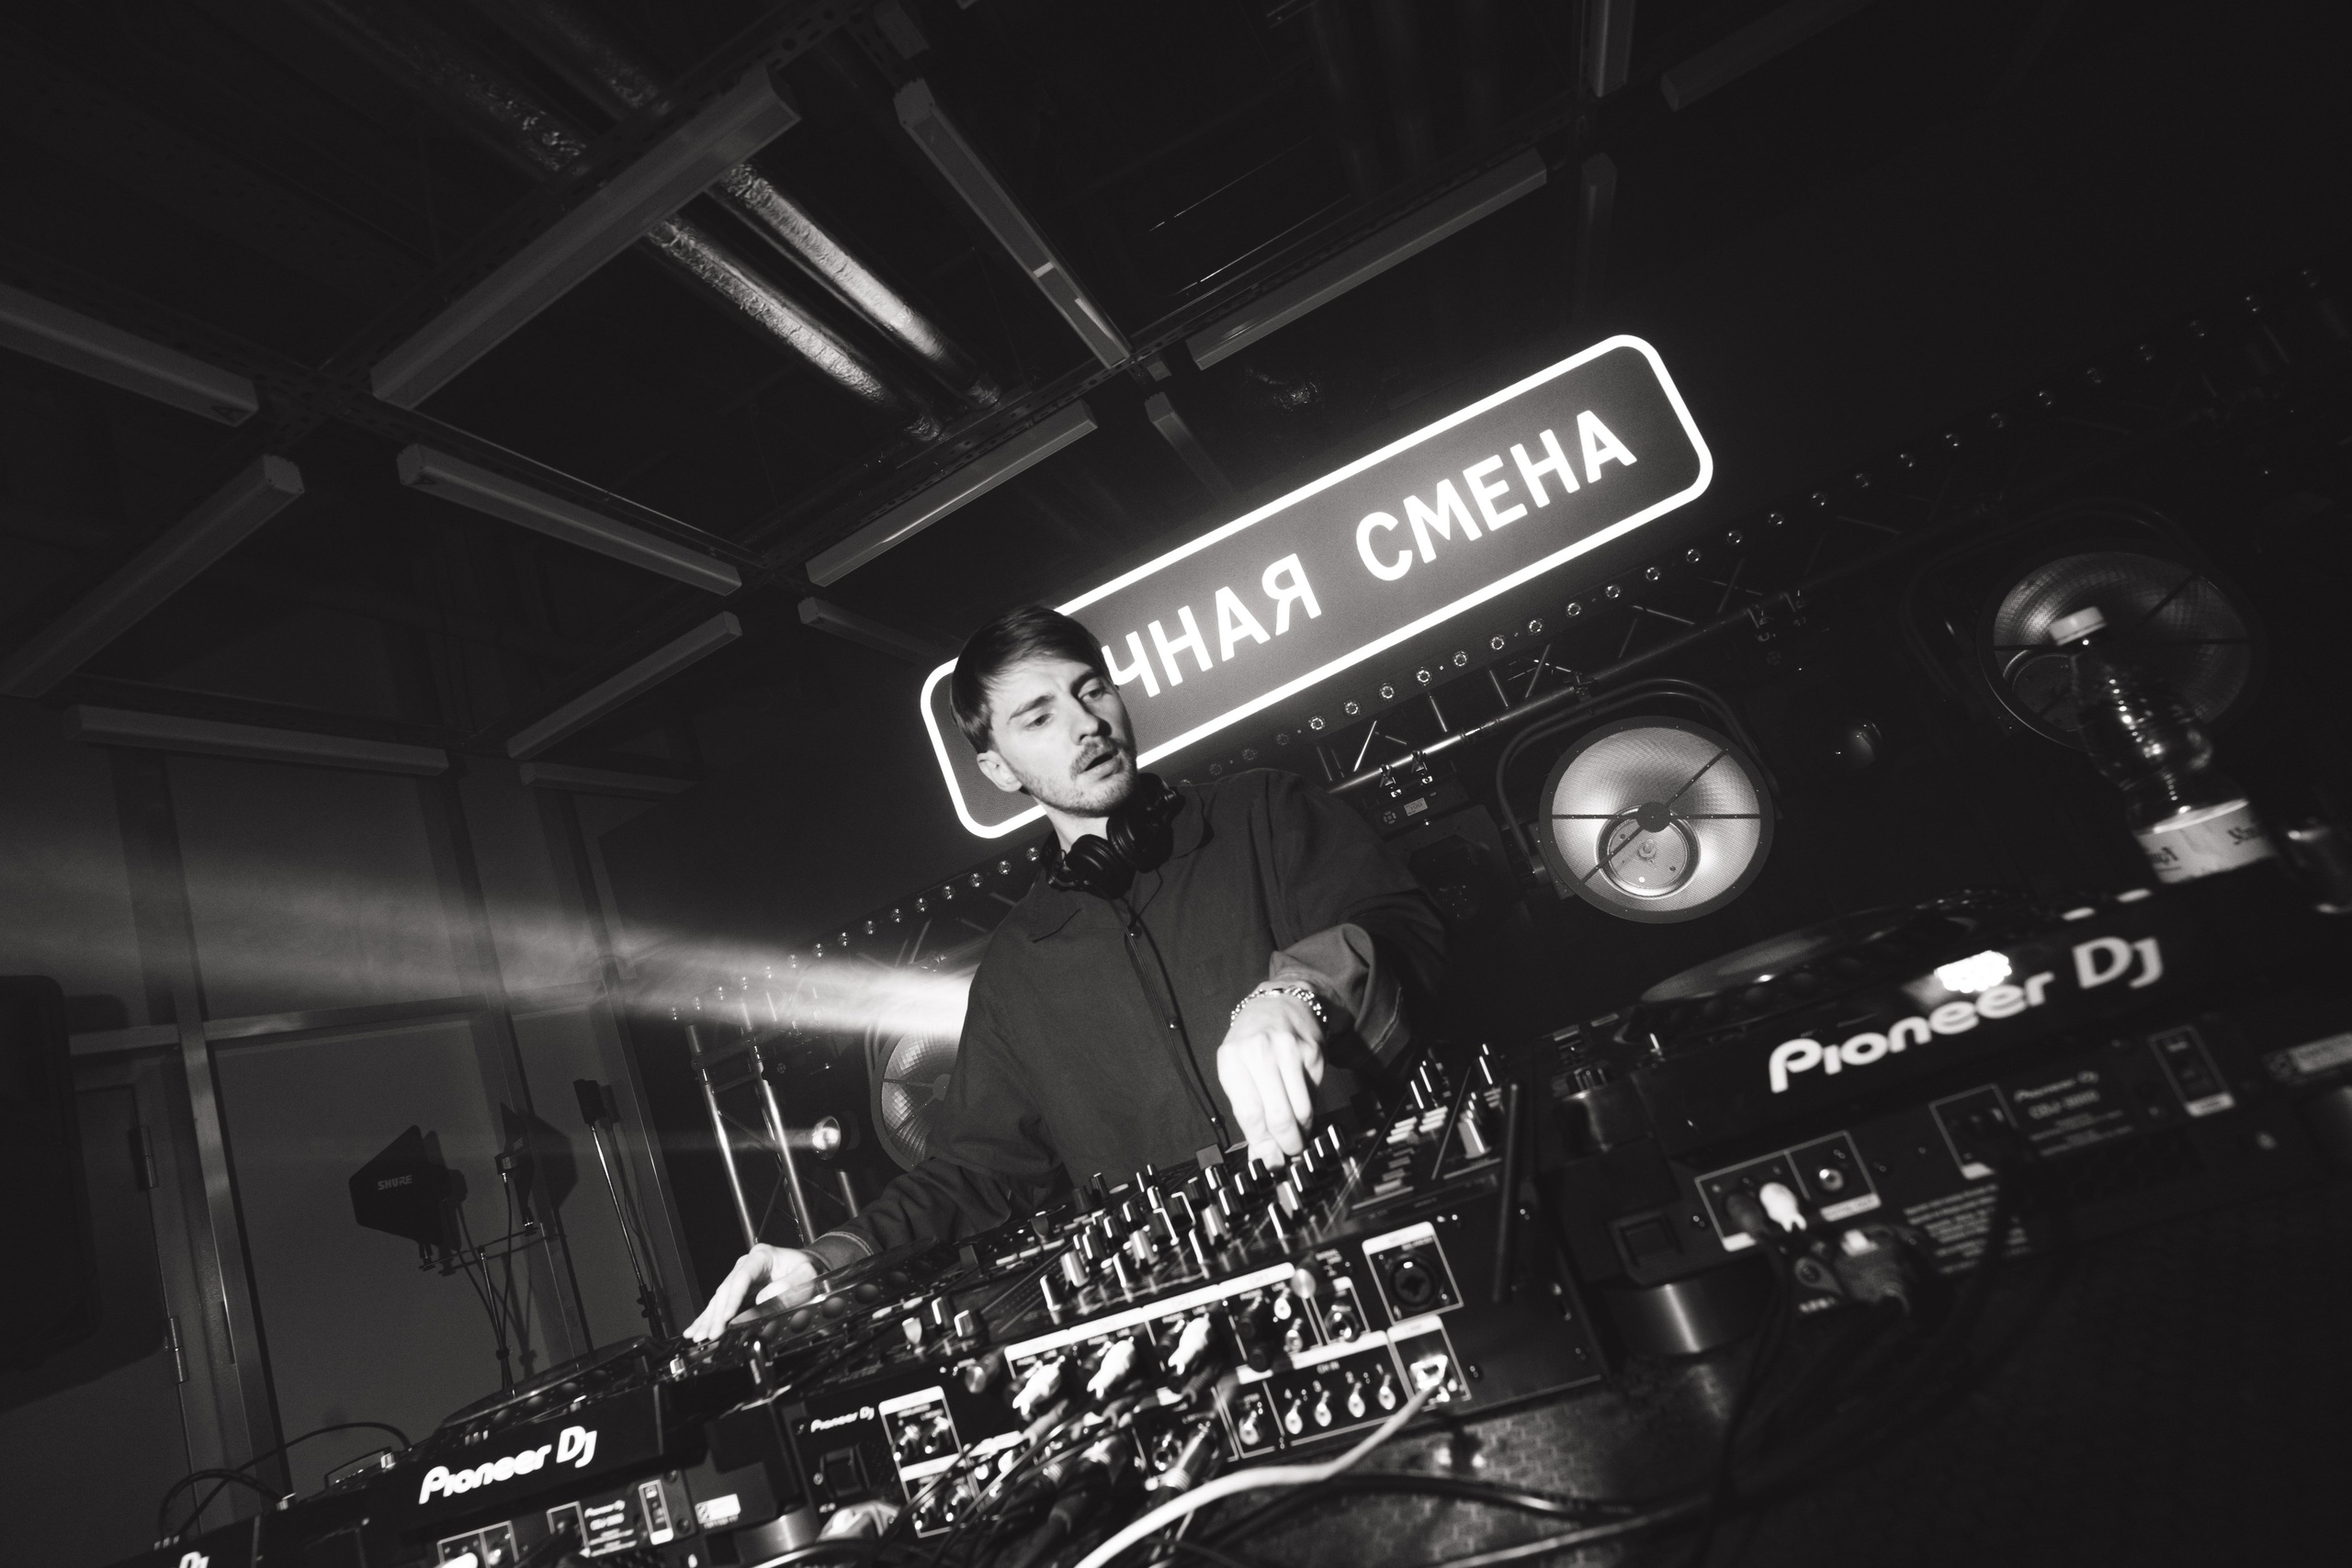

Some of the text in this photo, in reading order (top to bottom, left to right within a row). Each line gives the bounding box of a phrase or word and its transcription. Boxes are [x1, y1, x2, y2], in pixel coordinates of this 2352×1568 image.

[1102, 410, 1637, 698] ЧНАЯ СМЕНА
[1770, 970, 2054, 1093] Pioneer
[378, 1175, 413, 1190] SHURE
[810, 1412, 858, 1433] Pioneer
[418, 1444, 552, 1505] Pioneer
